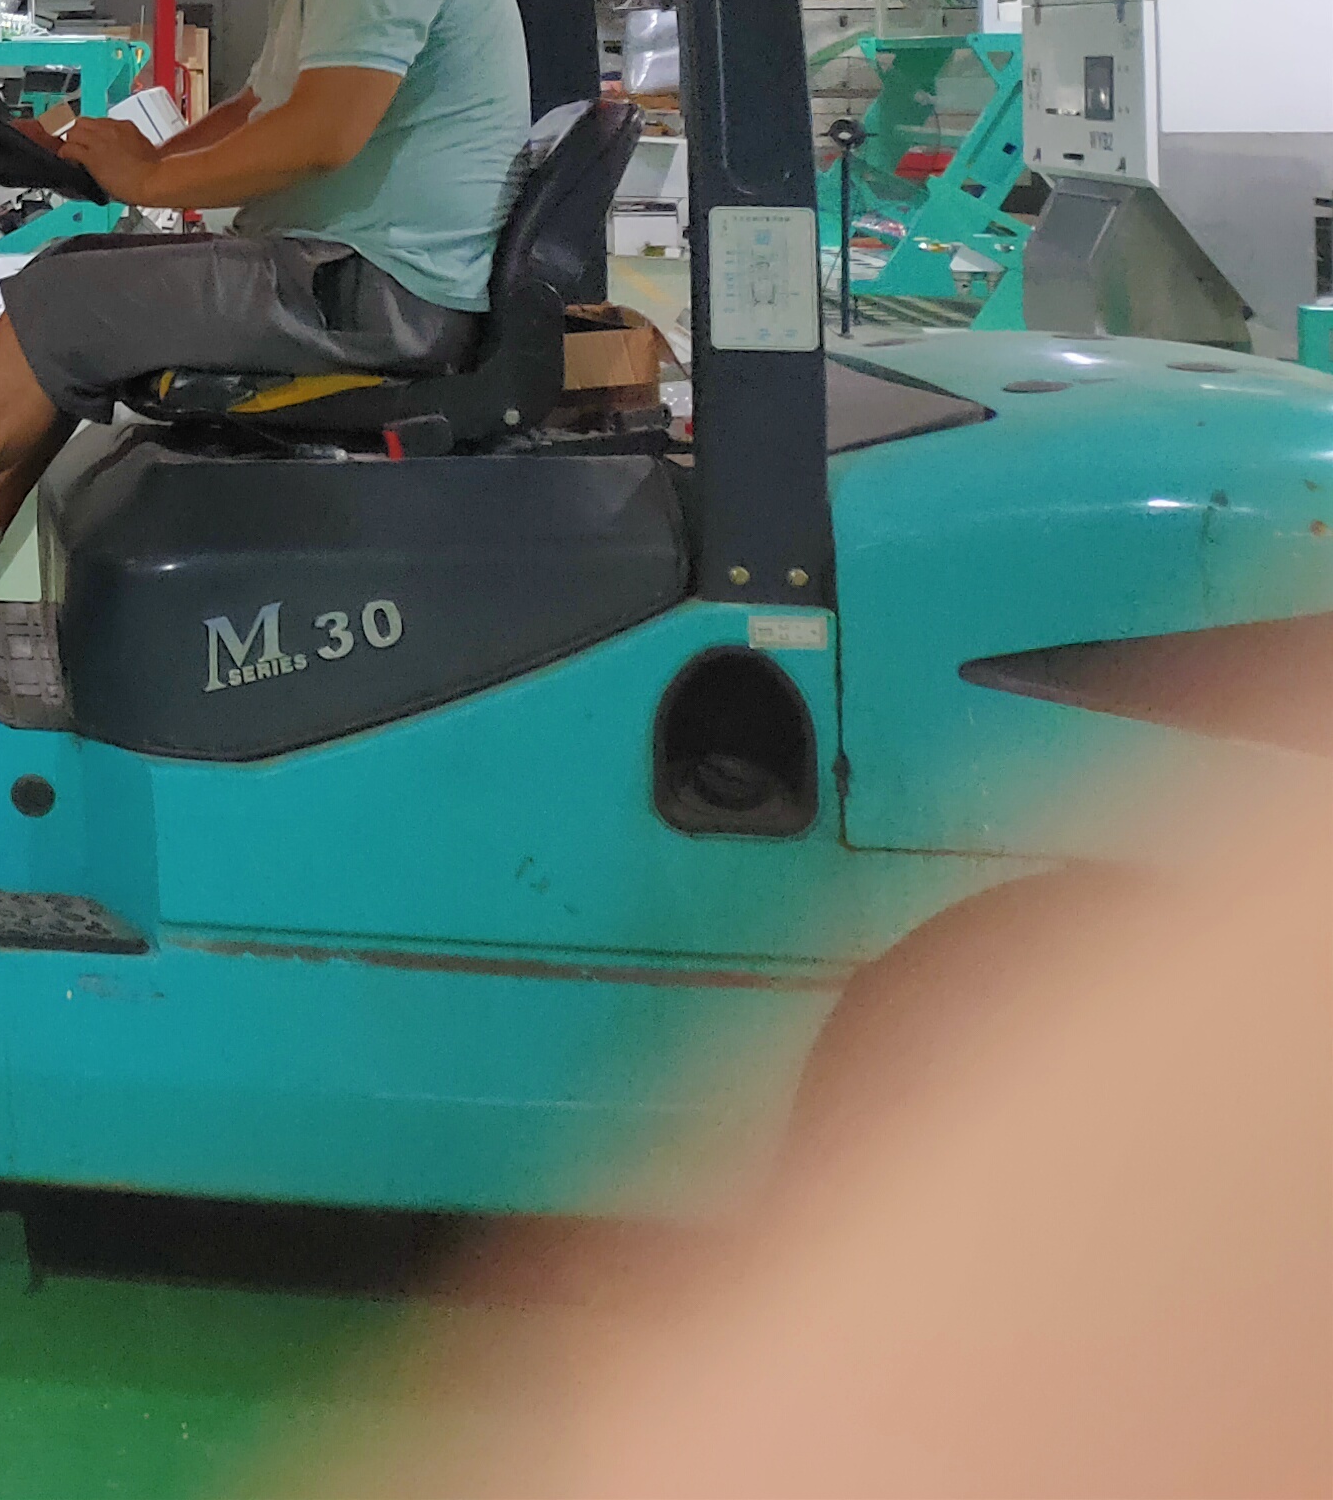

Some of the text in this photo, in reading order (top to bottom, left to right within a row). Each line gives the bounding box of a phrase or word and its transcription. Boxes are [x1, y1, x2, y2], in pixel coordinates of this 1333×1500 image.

[202, 600, 403, 692] M 30
[227, 653, 308, 687] SERIES
